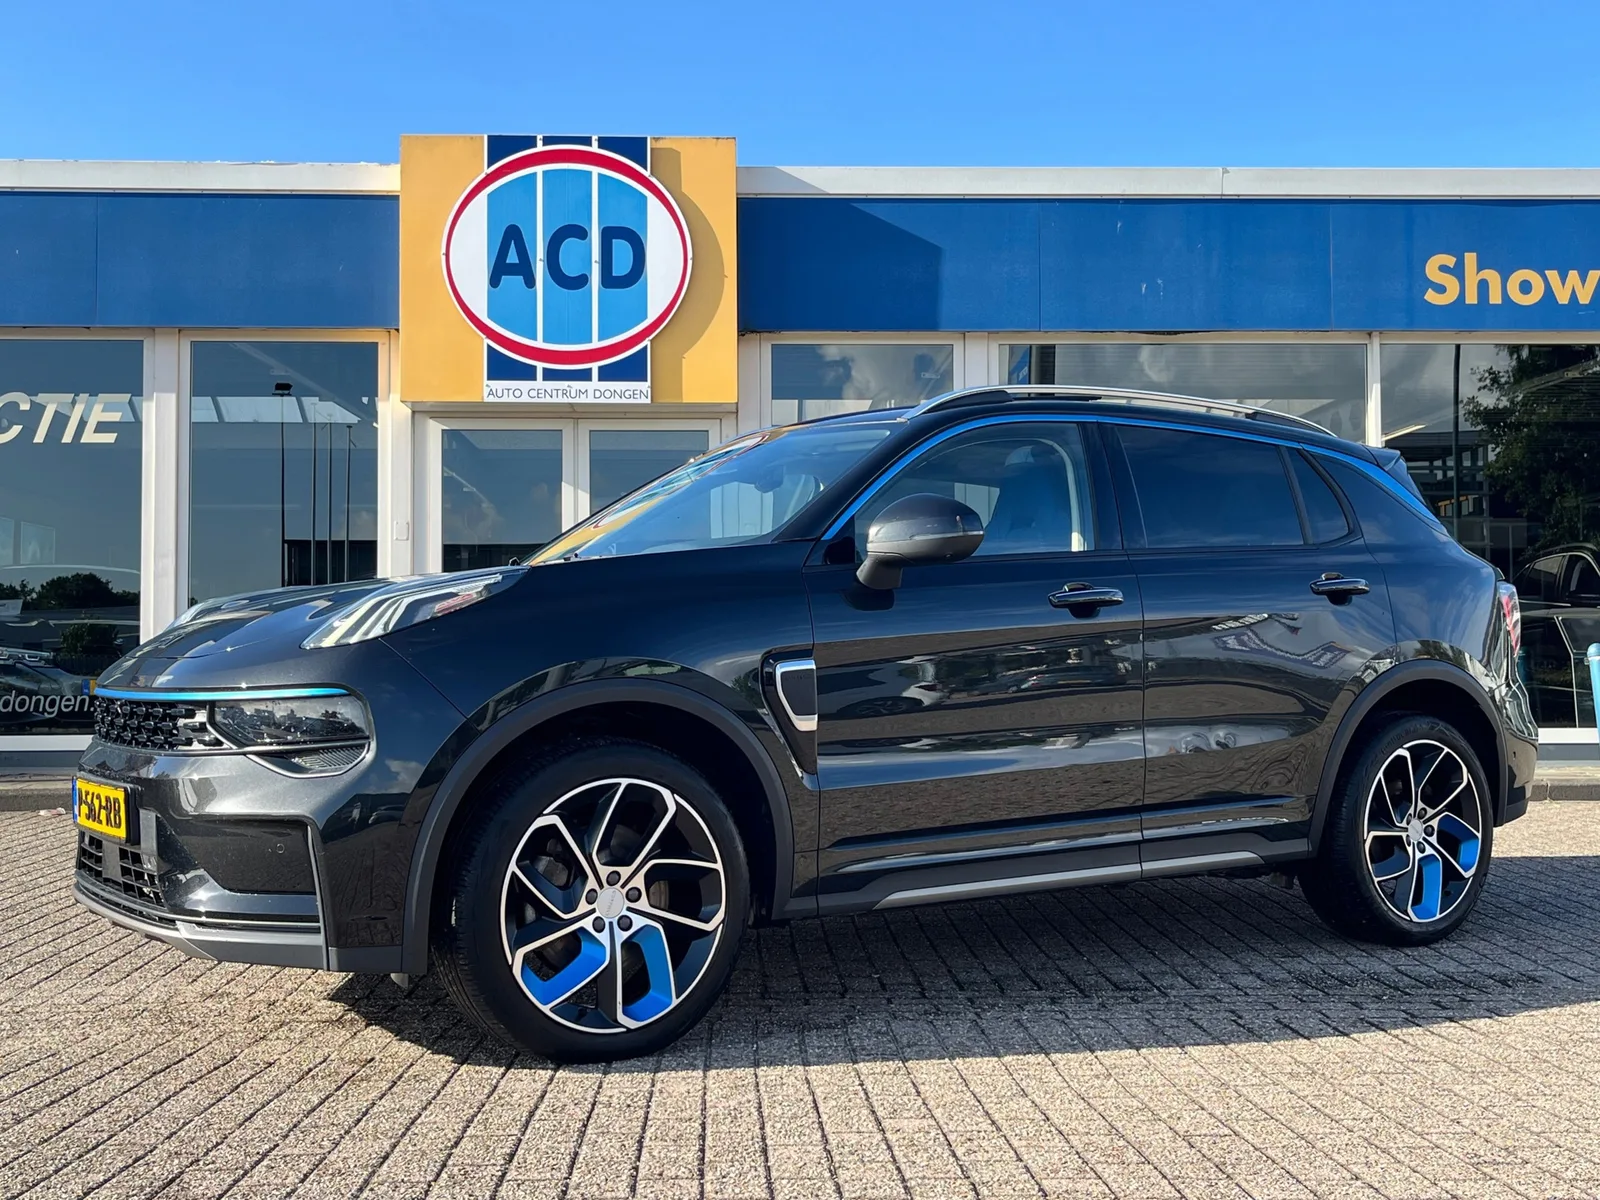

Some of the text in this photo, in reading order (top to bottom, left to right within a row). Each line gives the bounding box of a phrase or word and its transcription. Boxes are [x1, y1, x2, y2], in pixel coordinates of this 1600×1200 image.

[489, 223, 646, 291] ACD
[1423, 252, 1600, 306] Show
[486, 388, 649, 400] AUTO CENTRUM DONGEN
